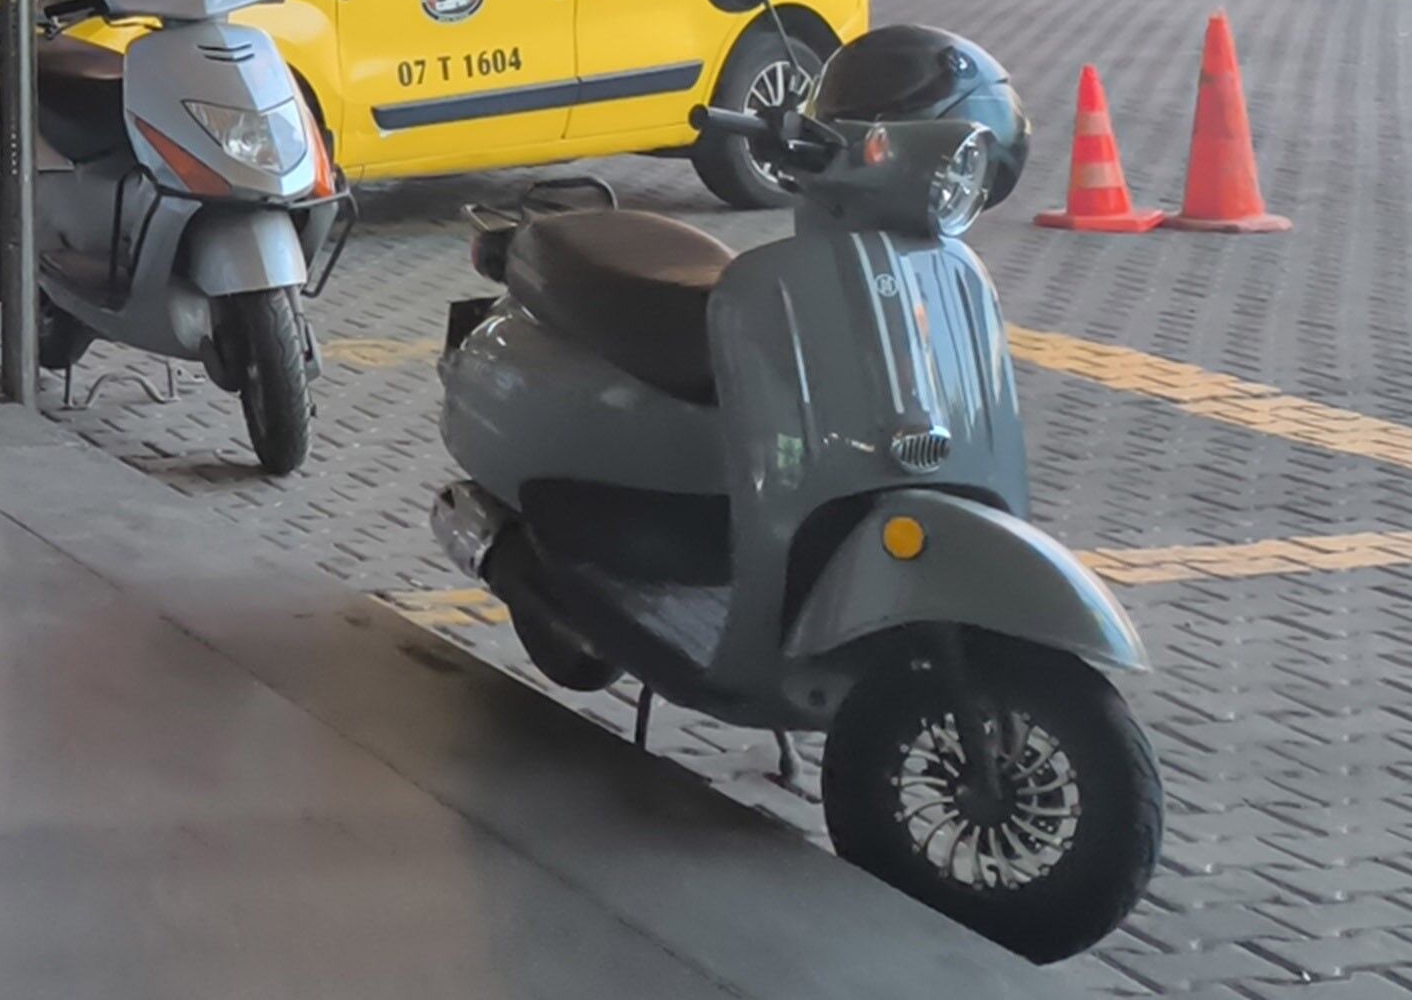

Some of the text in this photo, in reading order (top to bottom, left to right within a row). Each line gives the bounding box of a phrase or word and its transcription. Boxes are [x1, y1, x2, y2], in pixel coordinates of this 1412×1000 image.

[397, 46, 522, 87] 07 T 1604
